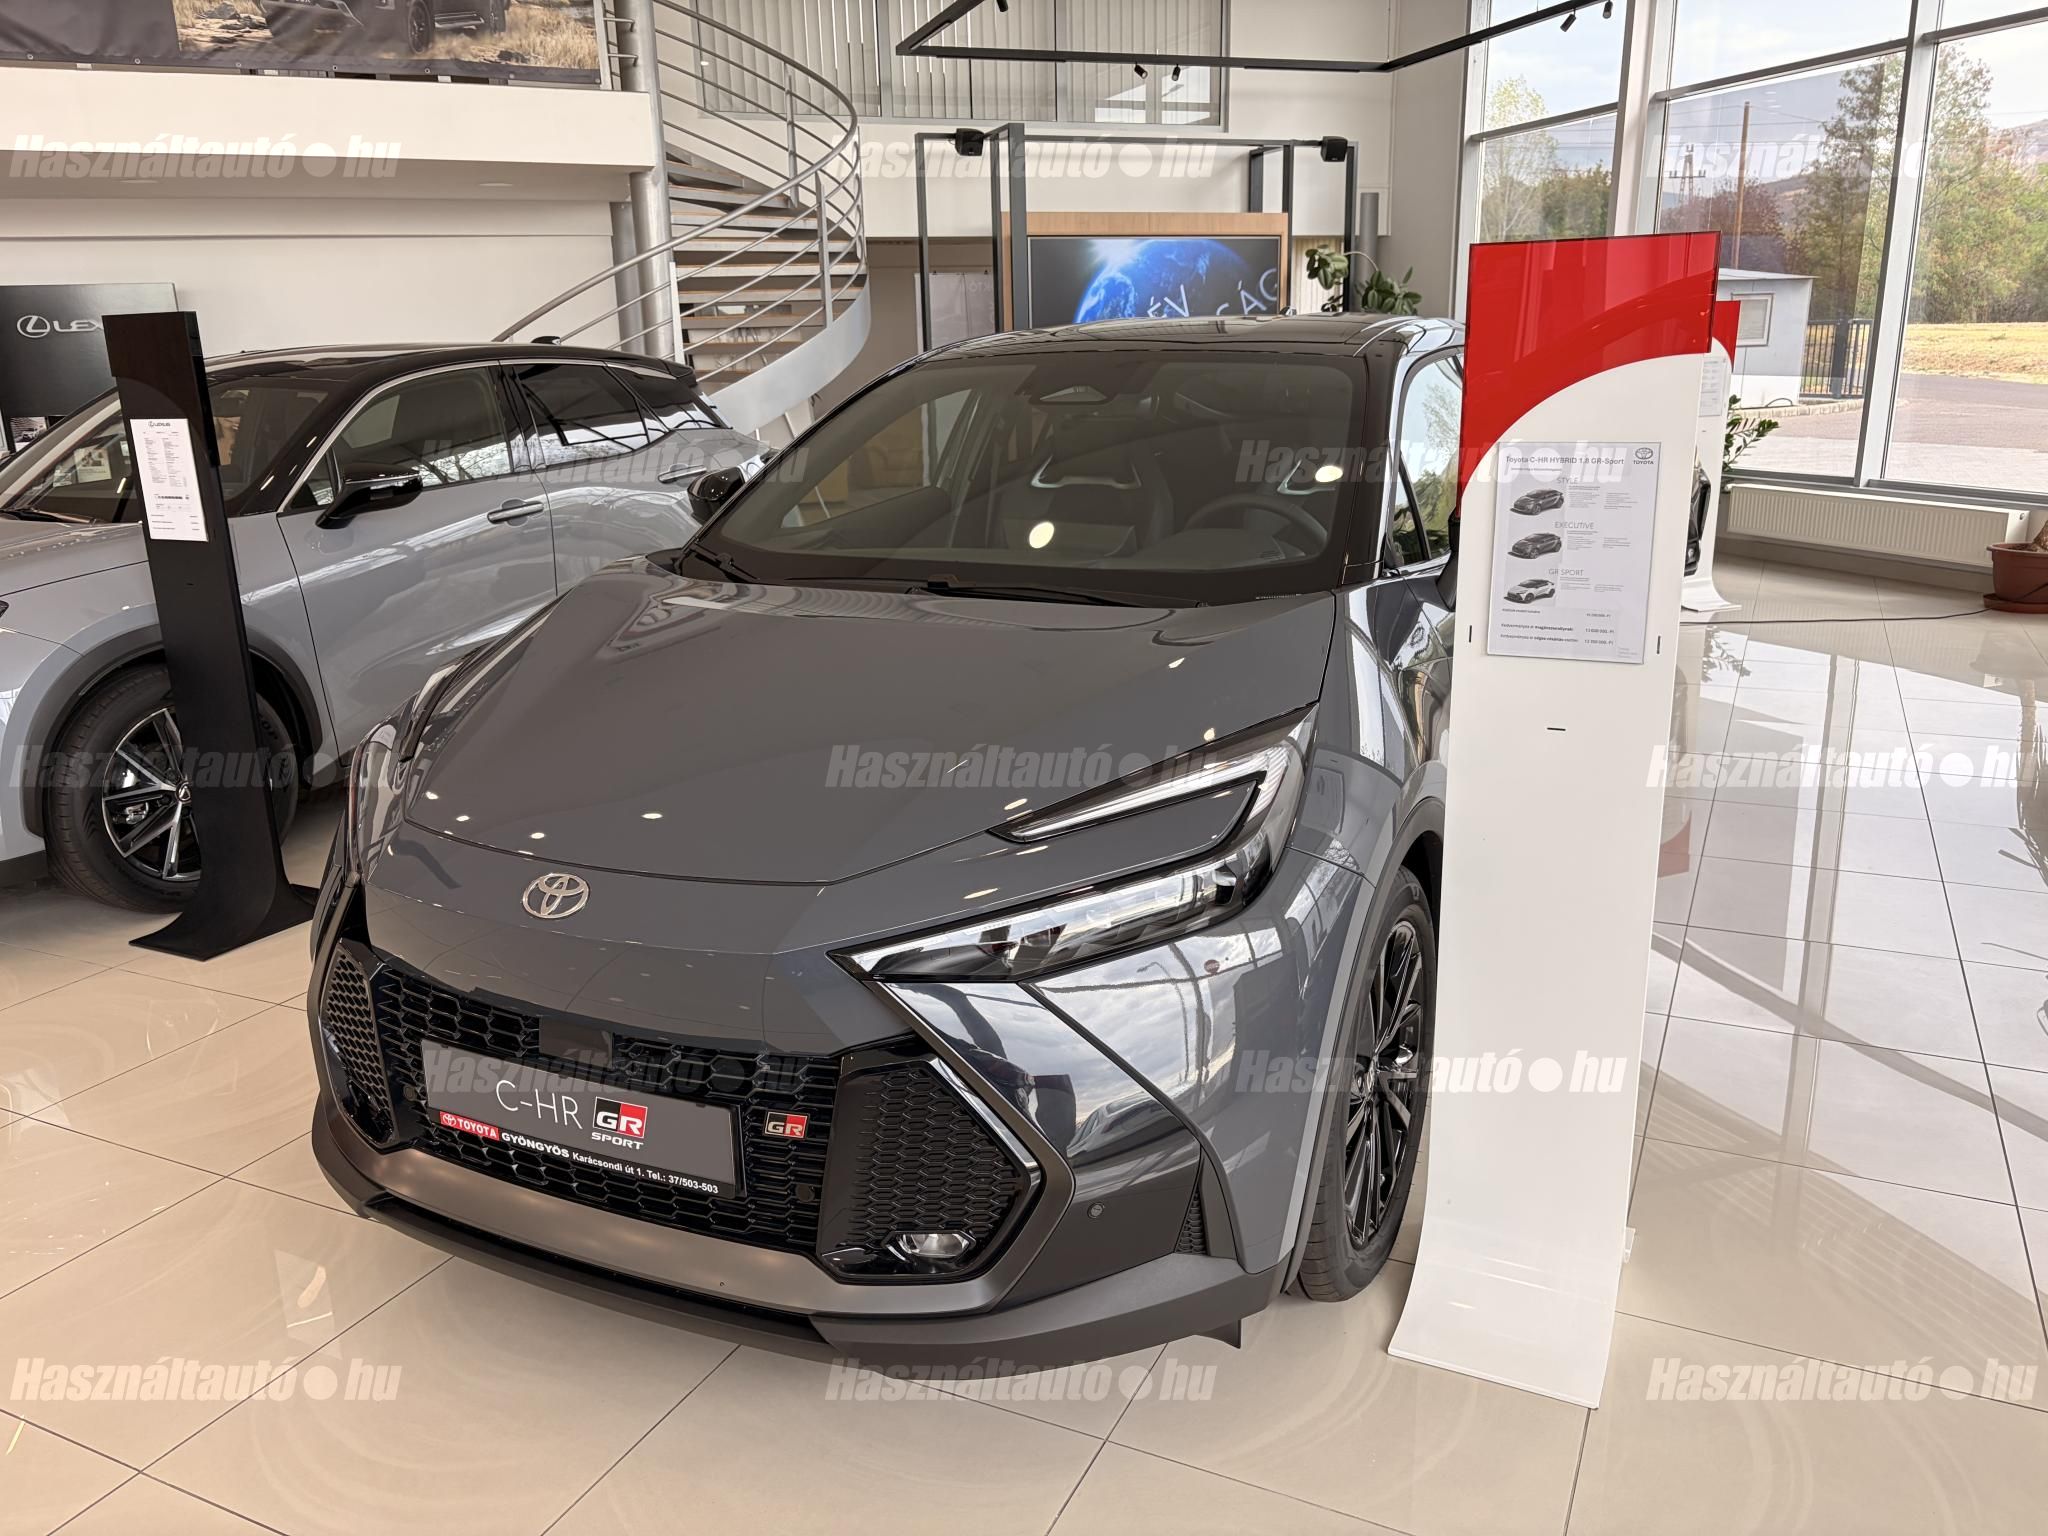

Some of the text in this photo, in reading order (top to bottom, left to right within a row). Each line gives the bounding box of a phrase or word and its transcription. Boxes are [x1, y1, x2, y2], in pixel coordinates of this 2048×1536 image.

[1591, 457, 1625, 466] GR-Sport
[1554, 521, 1595, 529] EXECUTIVE
[496, 1079, 583, 1130] C-HR
[595, 1111, 644, 1135] GR
[767, 1120, 806, 1139] GR
[591, 1132, 645, 1150] SPORT
[456, 1116, 719, 1194] TOYOTA GYÖNGYÖS Karácsondi út 1. Tel.: 37/503-503
